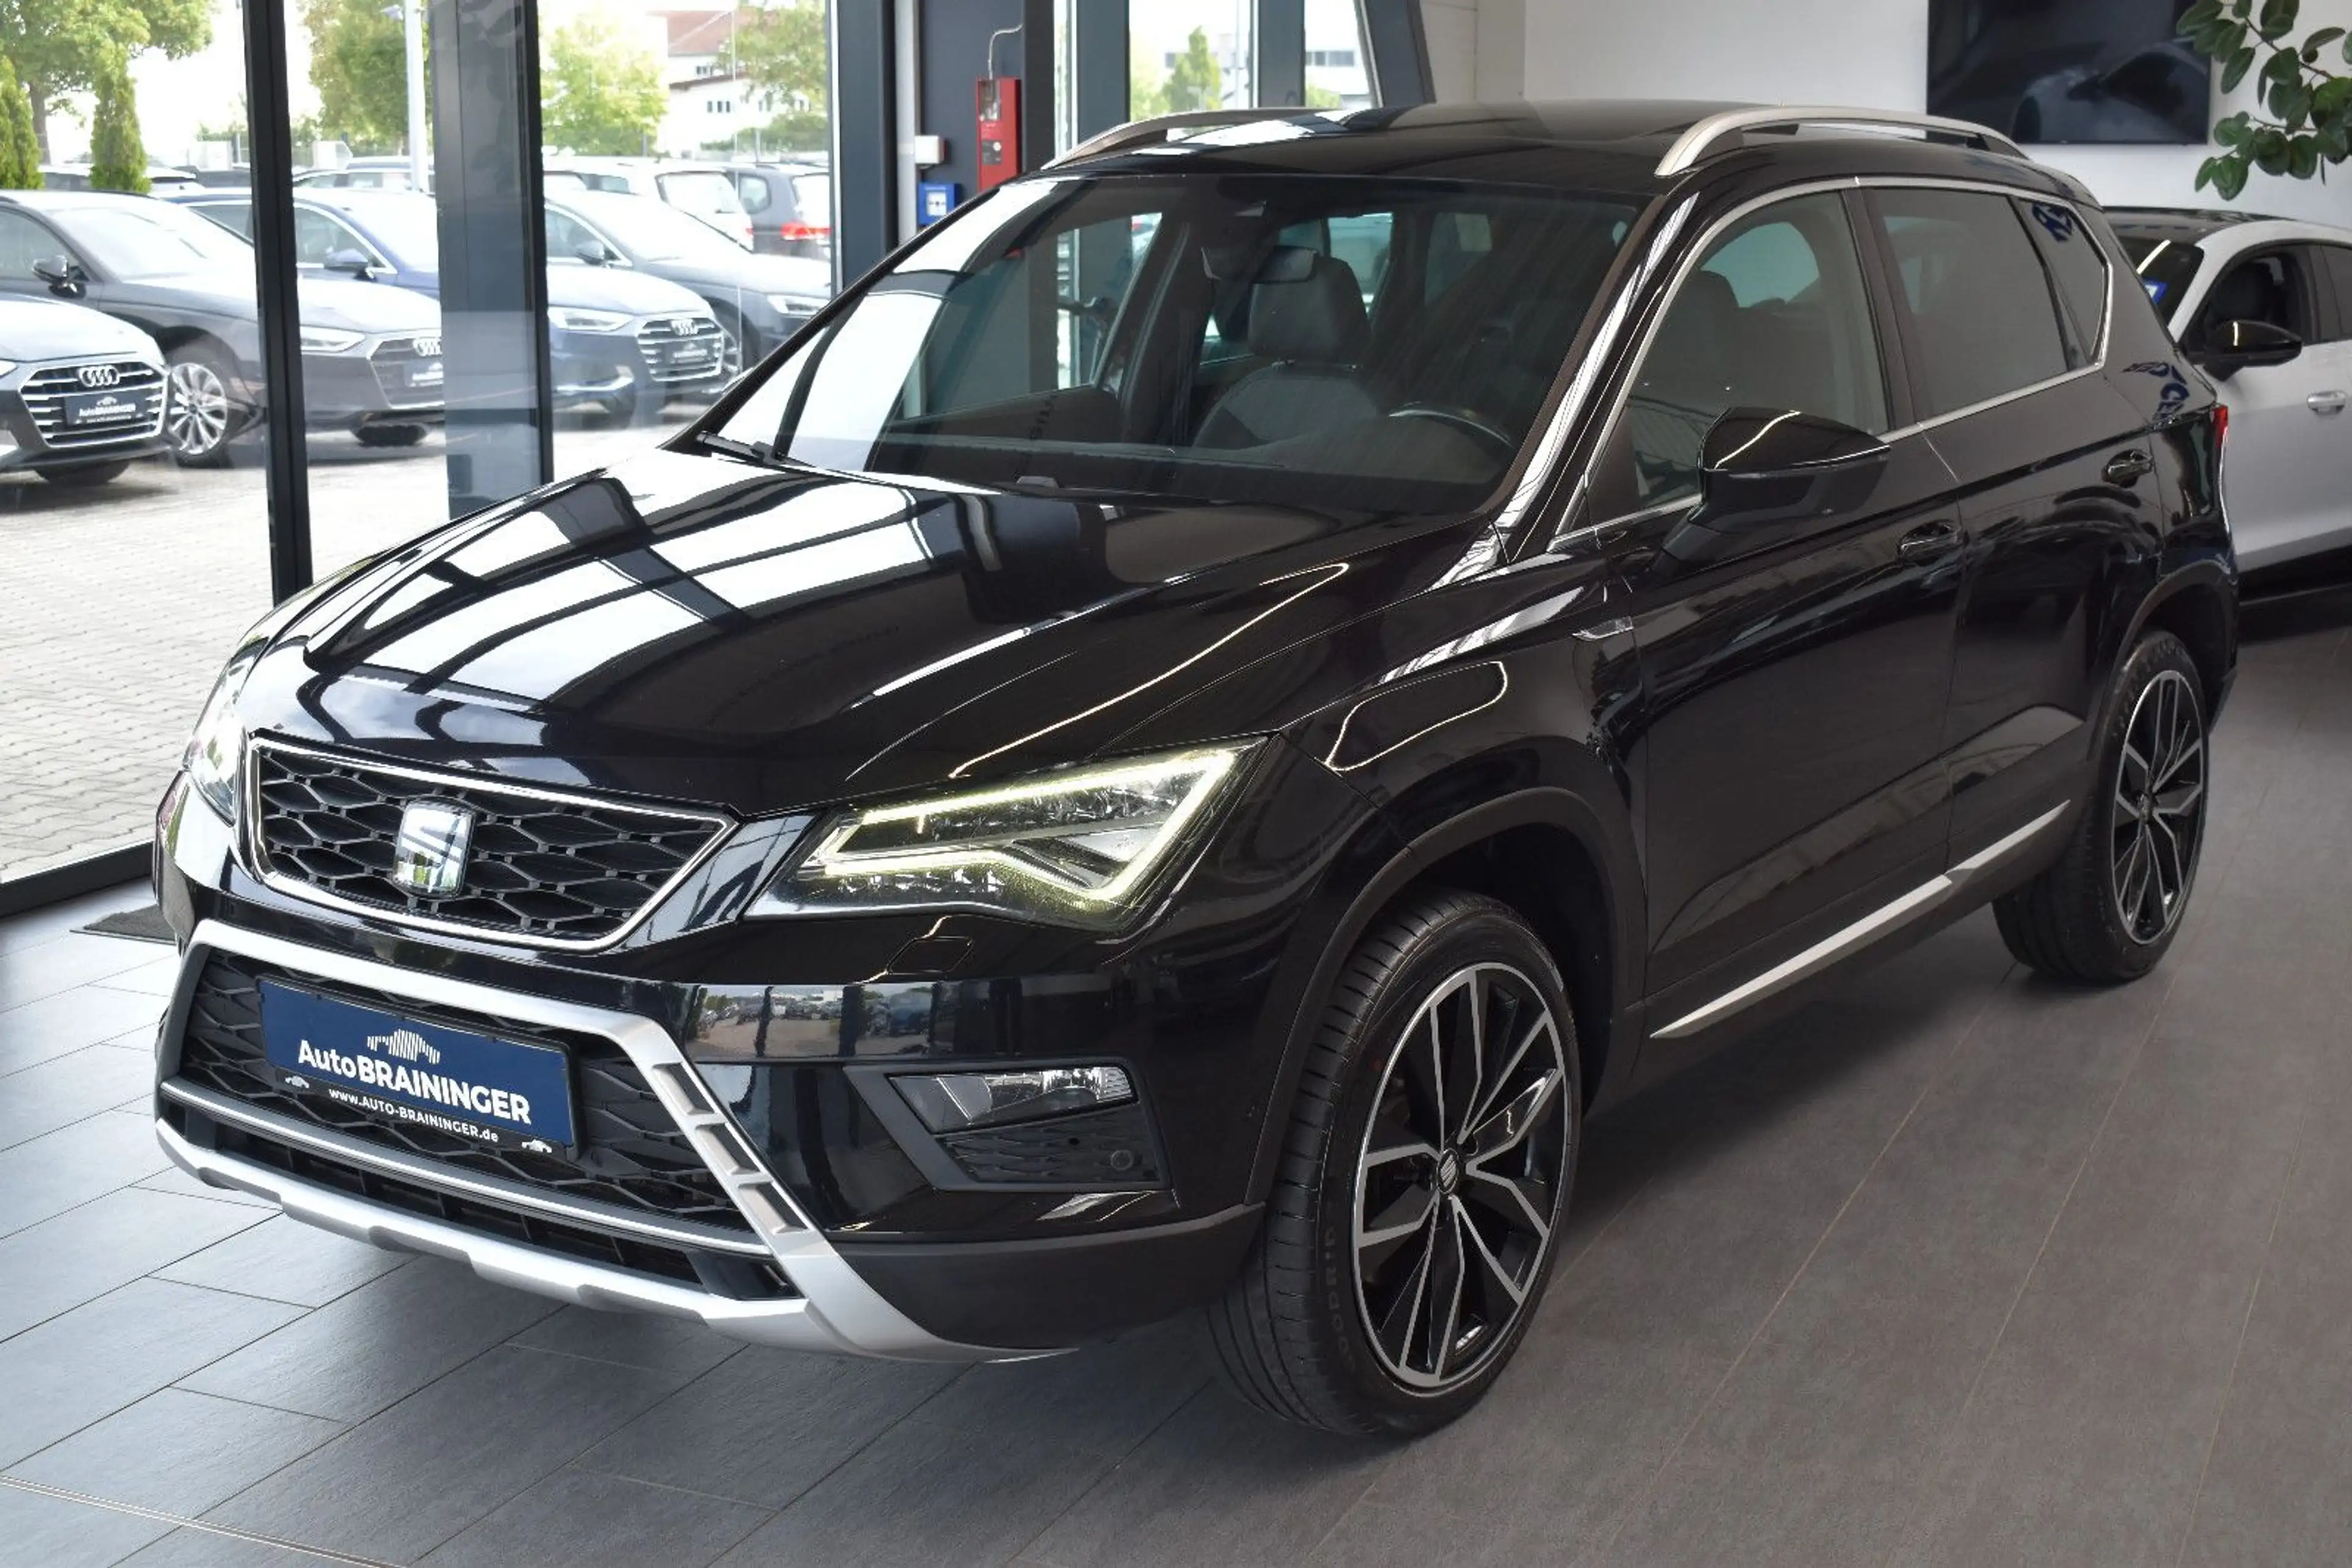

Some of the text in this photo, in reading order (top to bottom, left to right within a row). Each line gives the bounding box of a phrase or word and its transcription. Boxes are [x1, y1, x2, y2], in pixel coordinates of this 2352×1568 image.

[298, 1039, 531, 1125] AutoBRAININGER
[329, 1088, 499, 1142] www.AUTO-BRAININGER.de
[1324, 1202, 1355, 1371] GOODRID
